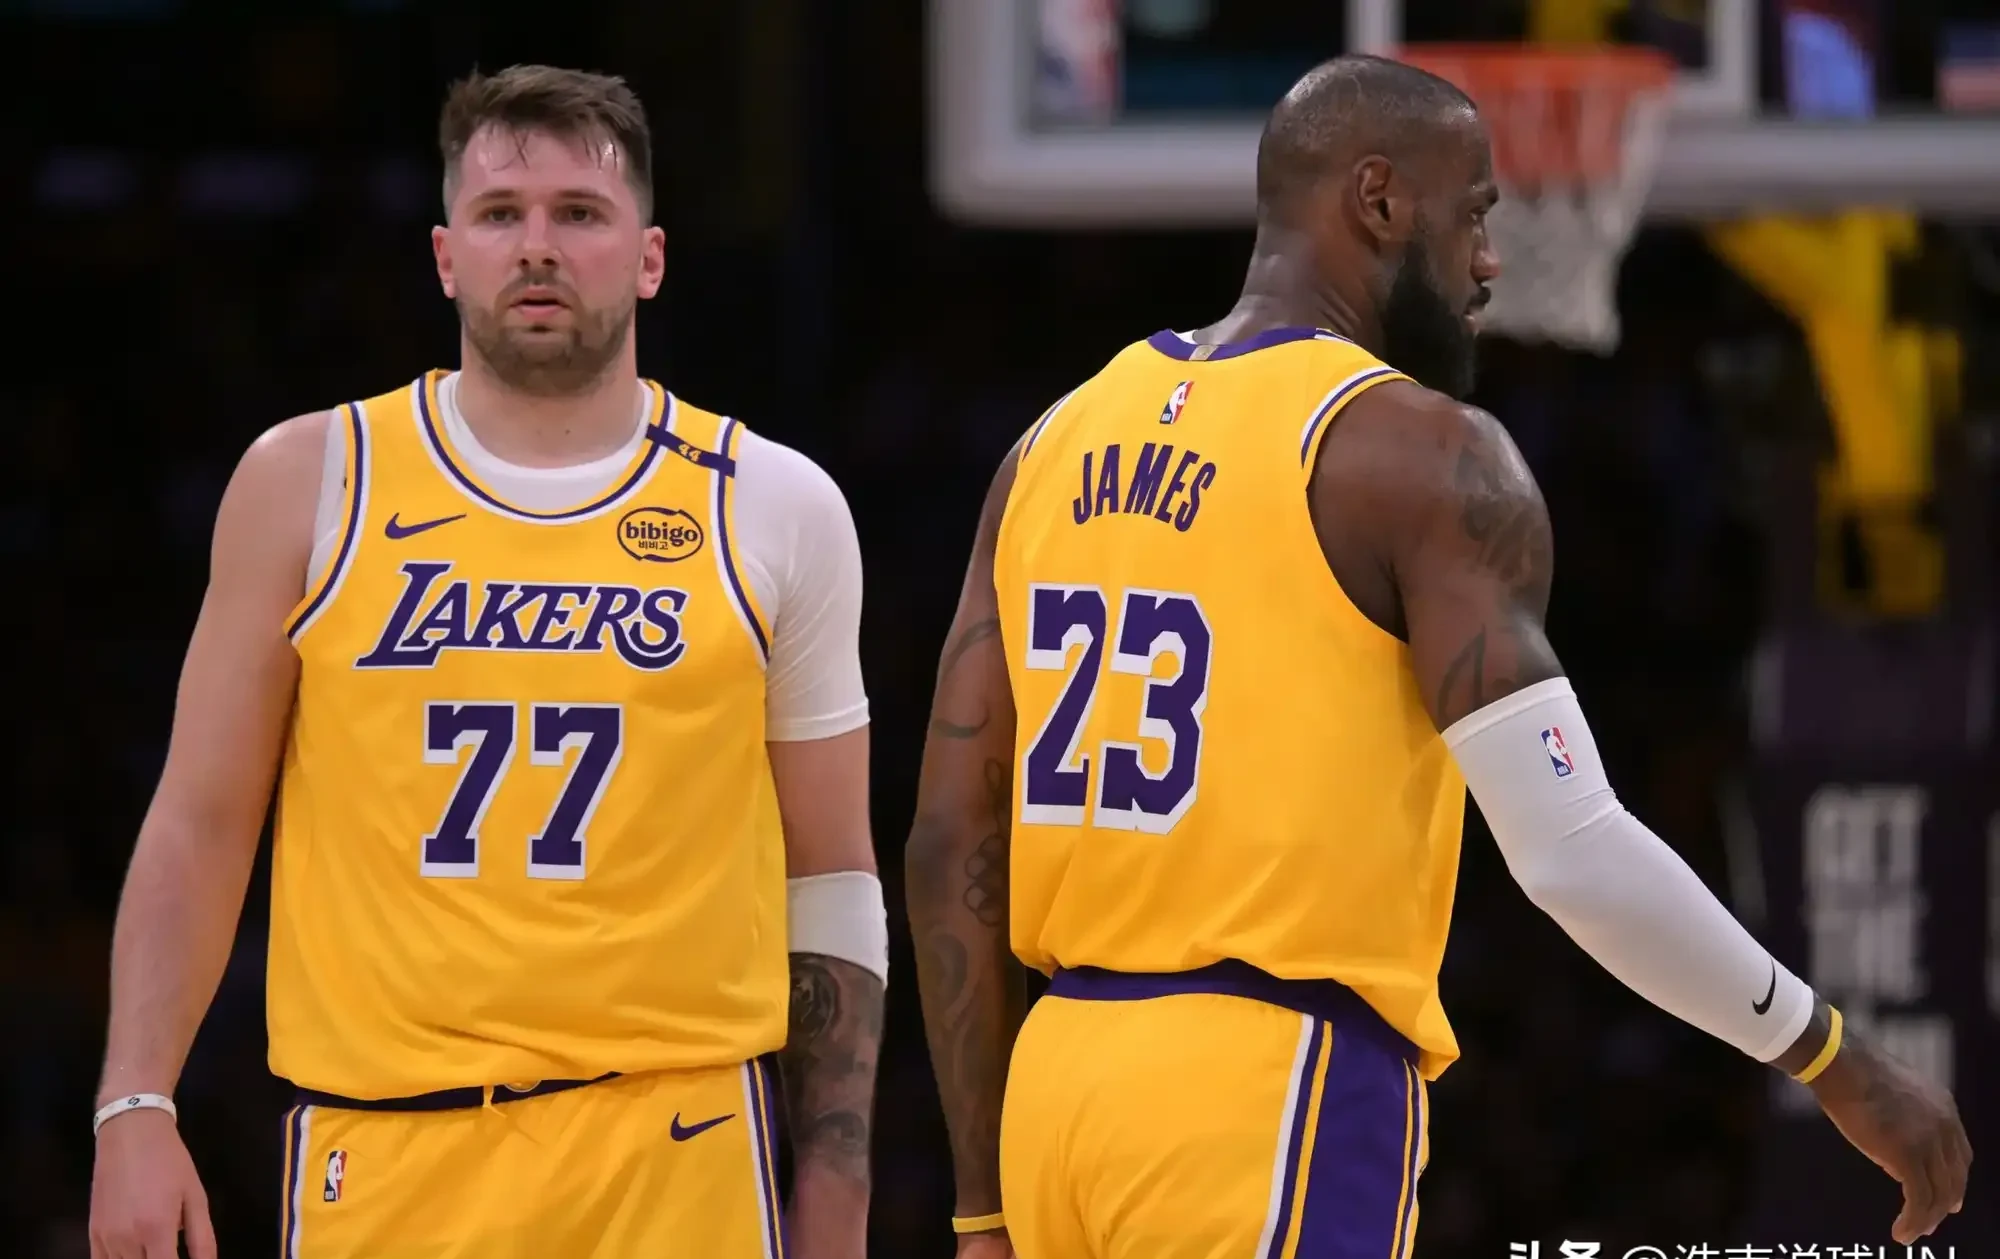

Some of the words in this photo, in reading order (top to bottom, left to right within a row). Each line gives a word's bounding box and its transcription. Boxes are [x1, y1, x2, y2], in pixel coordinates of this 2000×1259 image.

[678, 443, 701, 462] 44
[1073, 442, 1216, 532] JAMES
[626, 521, 698, 547] bibigo
[638, 540, 669, 550] 비비고
[353, 561, 689, 671] LAKERS
[1021, 582, 1213, 835] 23
[420, 701, 624, 879] 77
